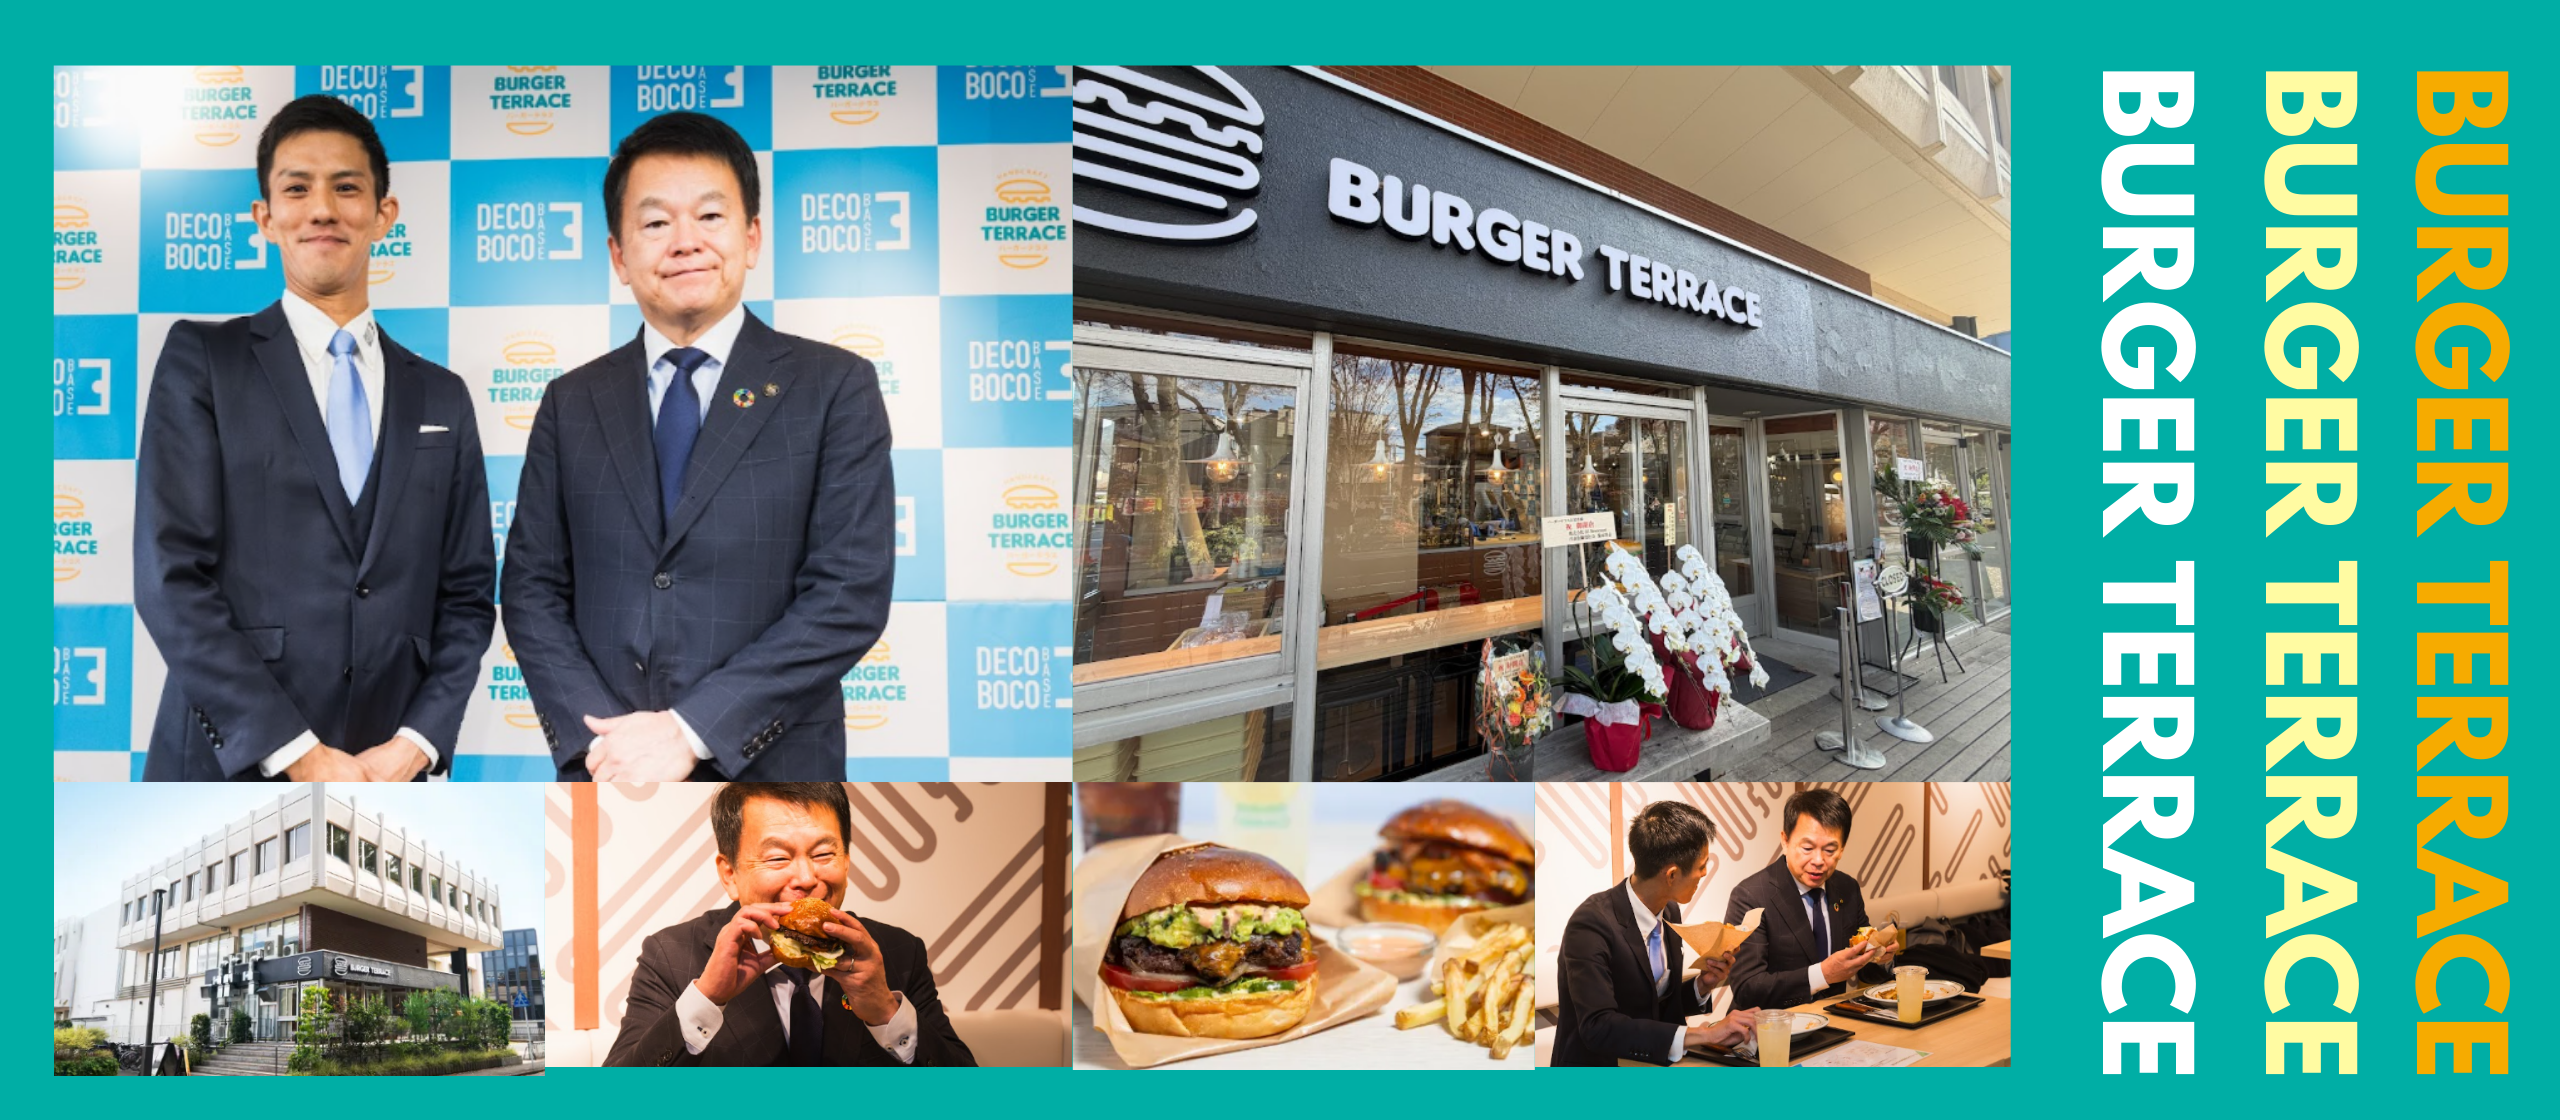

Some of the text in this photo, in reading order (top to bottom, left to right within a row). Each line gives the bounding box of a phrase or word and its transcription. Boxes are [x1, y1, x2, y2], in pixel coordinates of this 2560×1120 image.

[321, 65, 377, 91] DECO
[494, 75, 566, 91] BURGER
[818, 65, 891, 80] BURGER
[966, 71, 1026, 100] BOCO
[1028, 65, 1036, 98] SE
[184, 87, 252, 101] BURGER
[489, 93, 571, 110] TERRACE
[637, 83, 696, 111] BOCO
[813, 81, 897, 98] TERRACE
[180, 105, 257, 120] TERRACE
[477, 202, 535, 231] DECO
[801, 193, 861, 221] DECO
[985, 206, 1061, 222] BURGER
[166, 212, 222, 239] DECO
[537, 203, 545, 260] BASE
[863, 193, 872, 251] BASE
[981, 225, 1067, 241] TERRACE
[224, 214, 232, 270] BASE
[477, 234, 535, 262] BOCO
[802, 224, 861, 253] BOCO
[1328, 157, 1763, 329] BURGER TERRACE
[165, 243, 222, 270] BOCO
[969, 340, 1031, 369] DECO
[492, 367, 564, 385] BURGER
[1033, 341, 1042, 401] BASE
[66, 358, 75, 416] BASE
[969, 372, 1031, 402] BOCO
[992, 512, 1069, 529] BURGER
[987, 531, 1073, 548] TERRACE
[1880, 571, 1903, 588] CLOSED
[976, 646, 1039, 676] DECO
[62, 647, 71, 705] BASE
[1042, 646, 1051, 708] BASE
[977, 679, 1040, 710] BOCO
